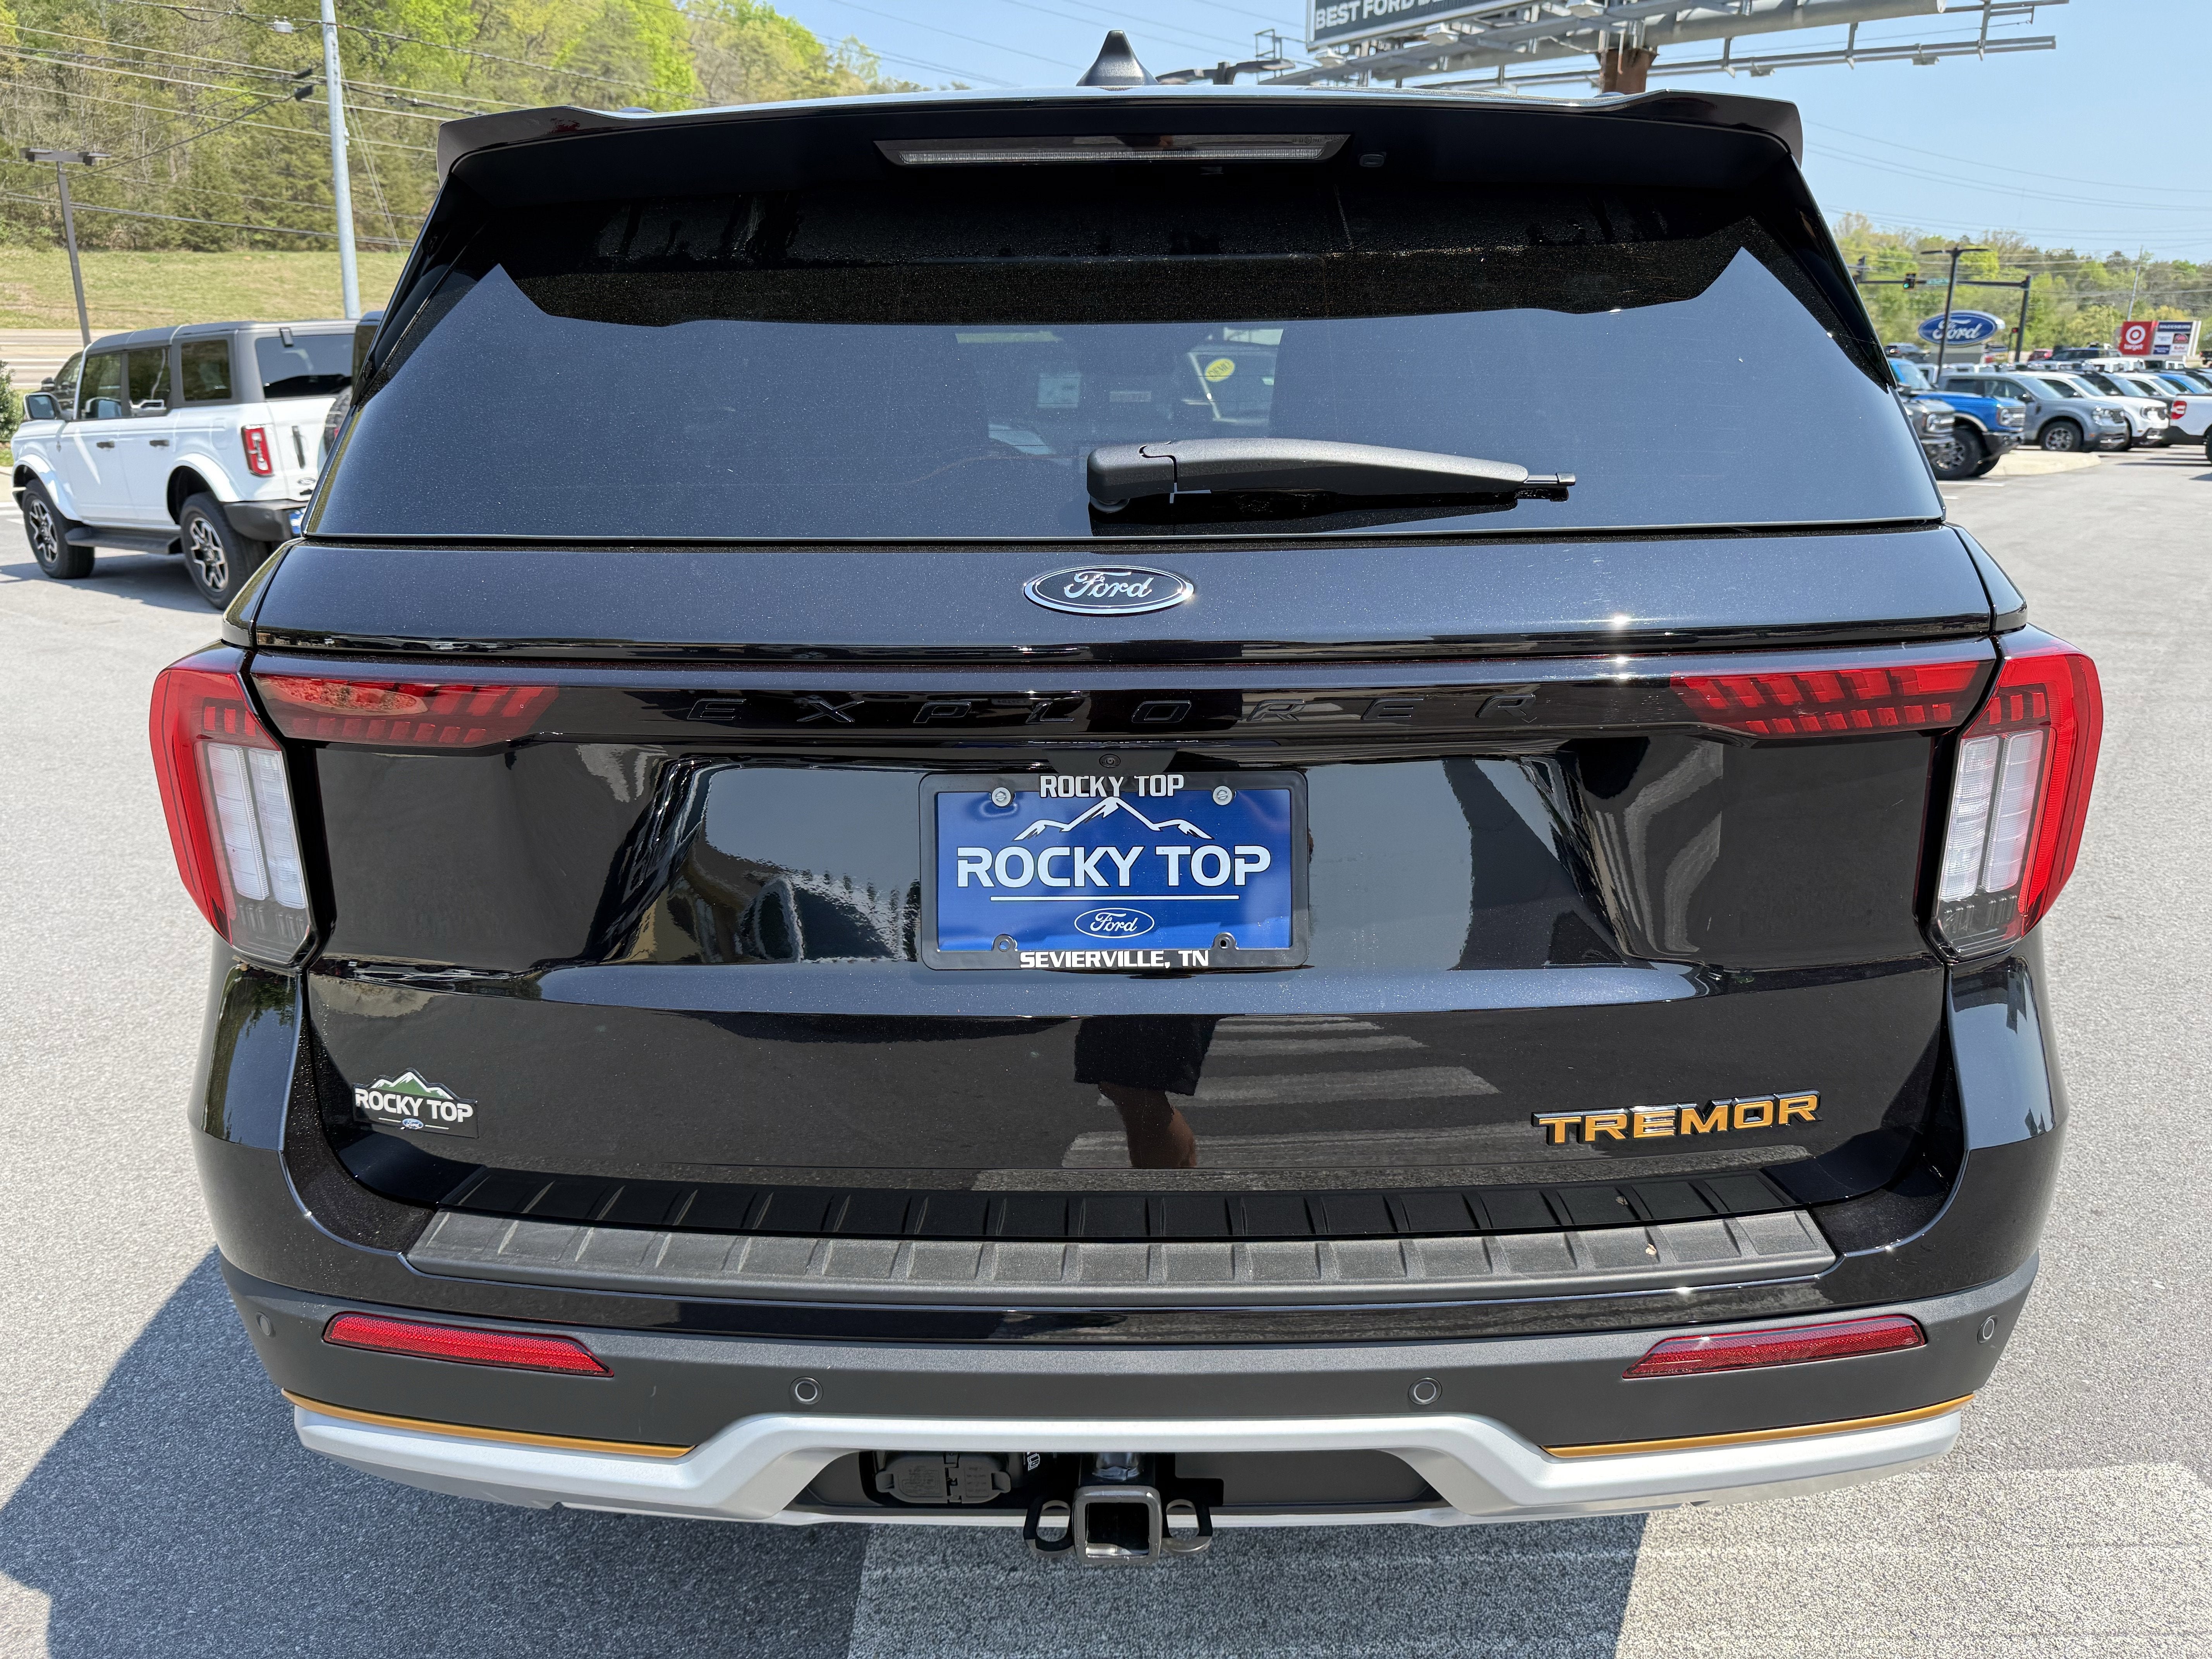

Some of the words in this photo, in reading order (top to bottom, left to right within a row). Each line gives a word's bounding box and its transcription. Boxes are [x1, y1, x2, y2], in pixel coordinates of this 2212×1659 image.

[1316, 1, 1360, 30] BEST
[1932, 319, 1982, 339] Ford
[1064, 571, 1154, 598] Ford
[687, 694, 1537, 723] EXPLORER
[1040, 775, 1124, 798] ROCKY
[1134, 775, 1184, 797] TOP
[957, 846, 1144, 887] ROCKY
[1156, 845, 1271, 886] TOP
[1090, 912, 1138, 933] Ford
[1020, 950, 1170, 969] SEVIERVILLE,
[1178, 950, 1209, 967] TN
[355, 1088, 424, 1116] ROCKY
[426, 1099, 473, 1122] TOP
[1532, 1089, 1821, 1145] TREMOR
